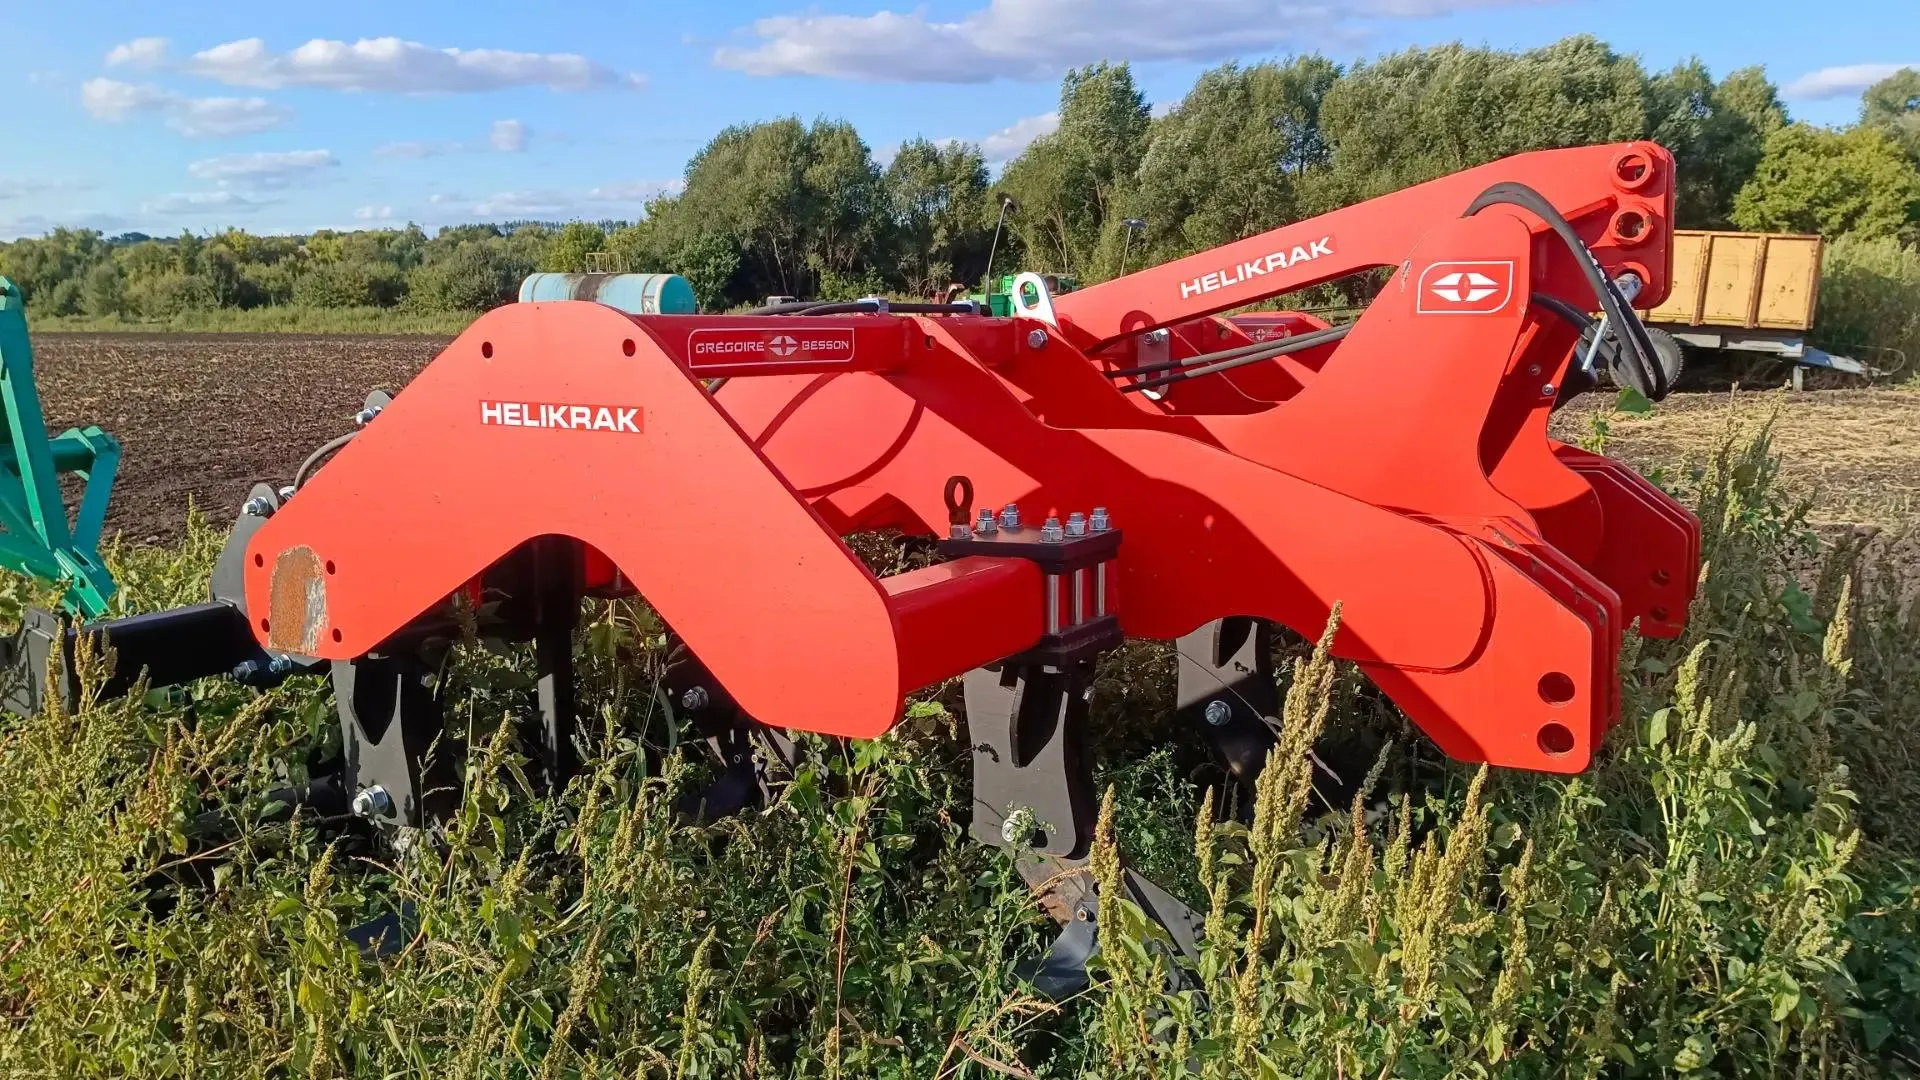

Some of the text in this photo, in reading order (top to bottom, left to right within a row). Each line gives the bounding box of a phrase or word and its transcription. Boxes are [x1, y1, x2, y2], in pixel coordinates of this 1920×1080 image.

[1180, 236, 1334, 299] HELIKRAK
[695, 340, 849, 354] GRÉGOIRE BESSON
[481, 401, 640, 433] HELIKRAK
